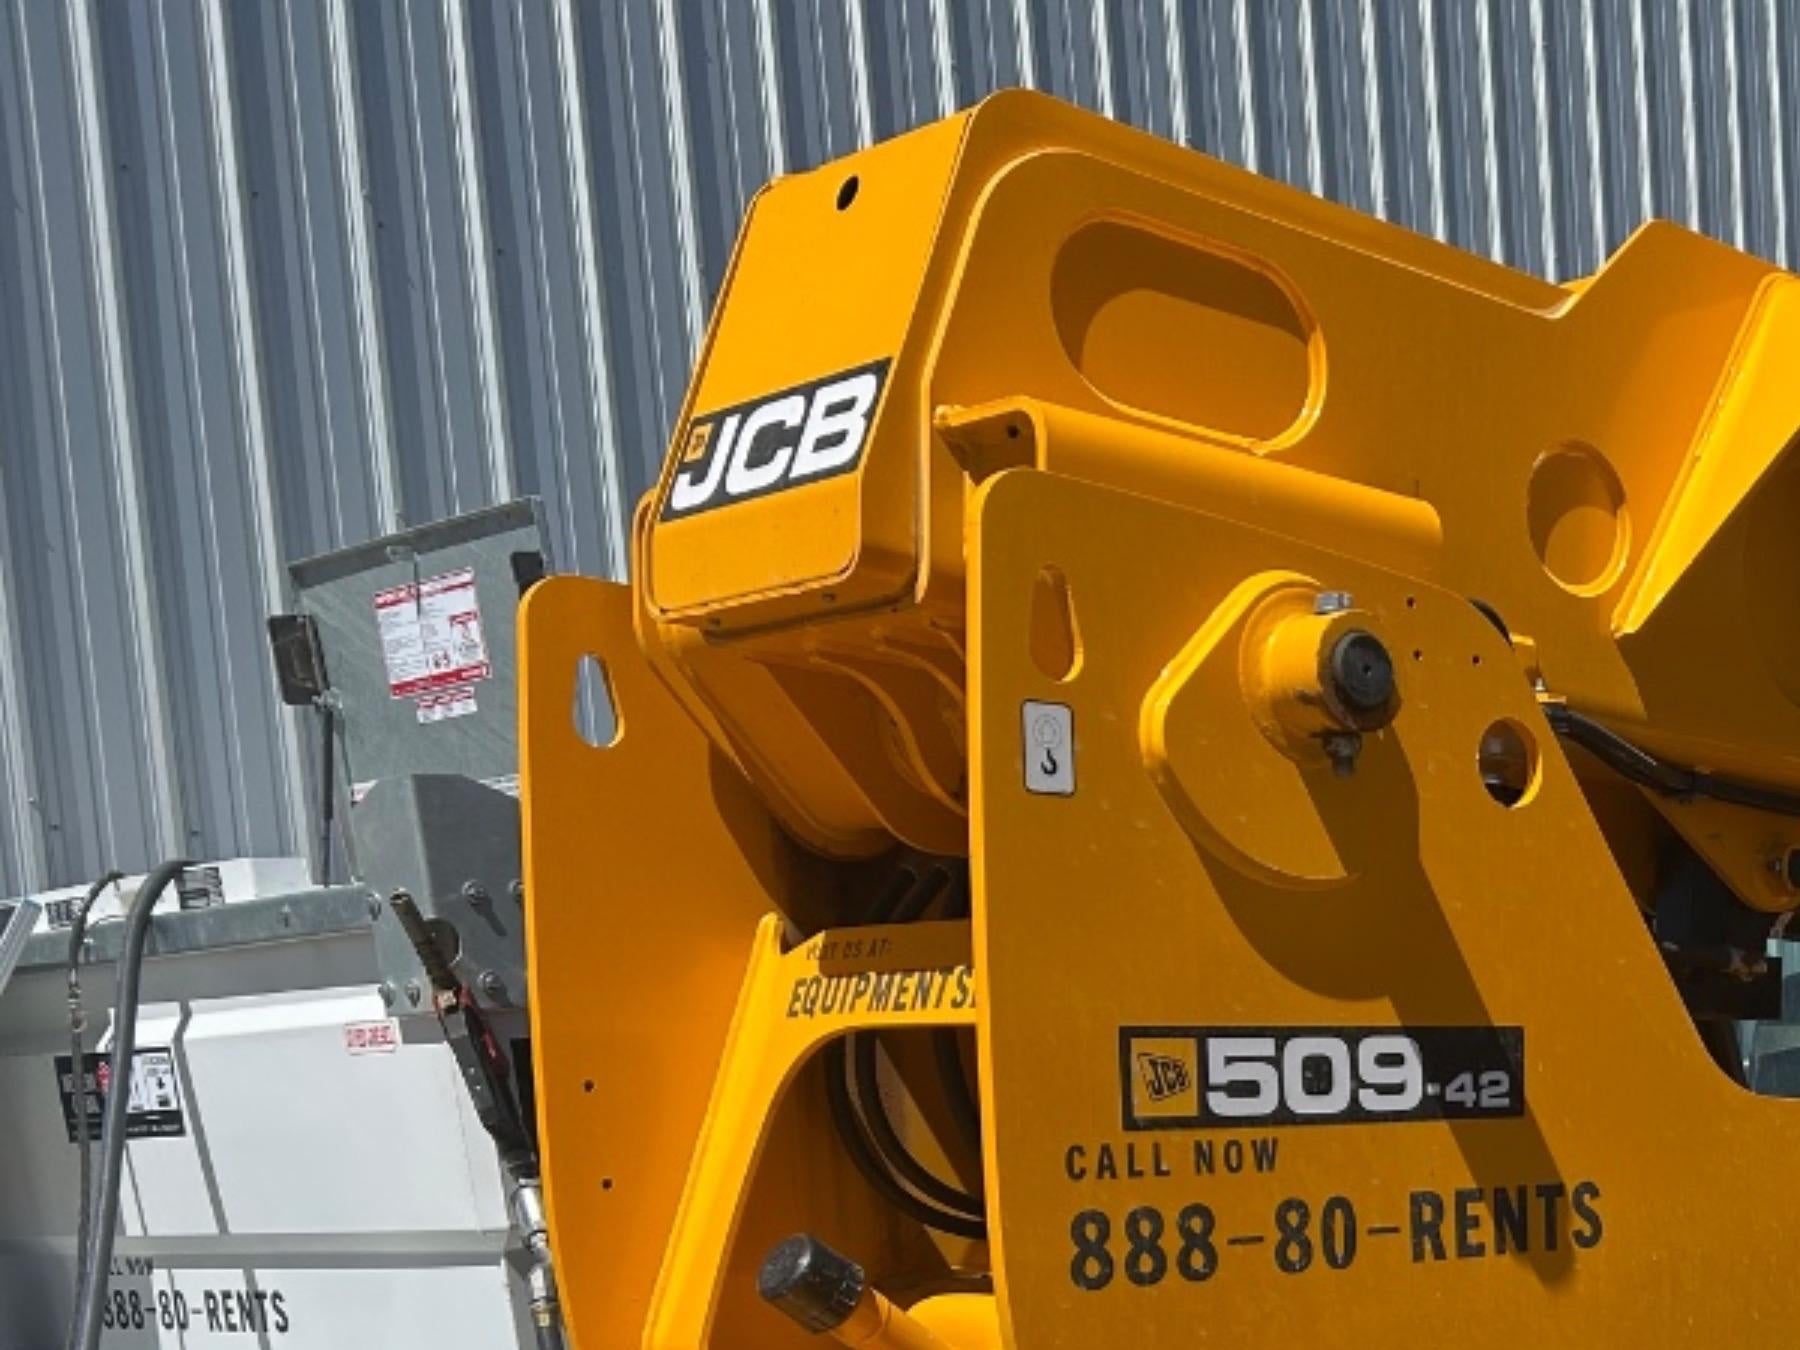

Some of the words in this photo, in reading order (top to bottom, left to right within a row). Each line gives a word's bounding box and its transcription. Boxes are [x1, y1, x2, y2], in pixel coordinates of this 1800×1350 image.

[671, 373, 878, 511] JCB
[786, 965, 975, 1019] EQUIPMENTS
[1065, 1142, 1171, 1181] CALL
[1194, 1138, 1280, 1175] NOW
[1069, 1180, 1604, 1291] 888-80-RENTS
